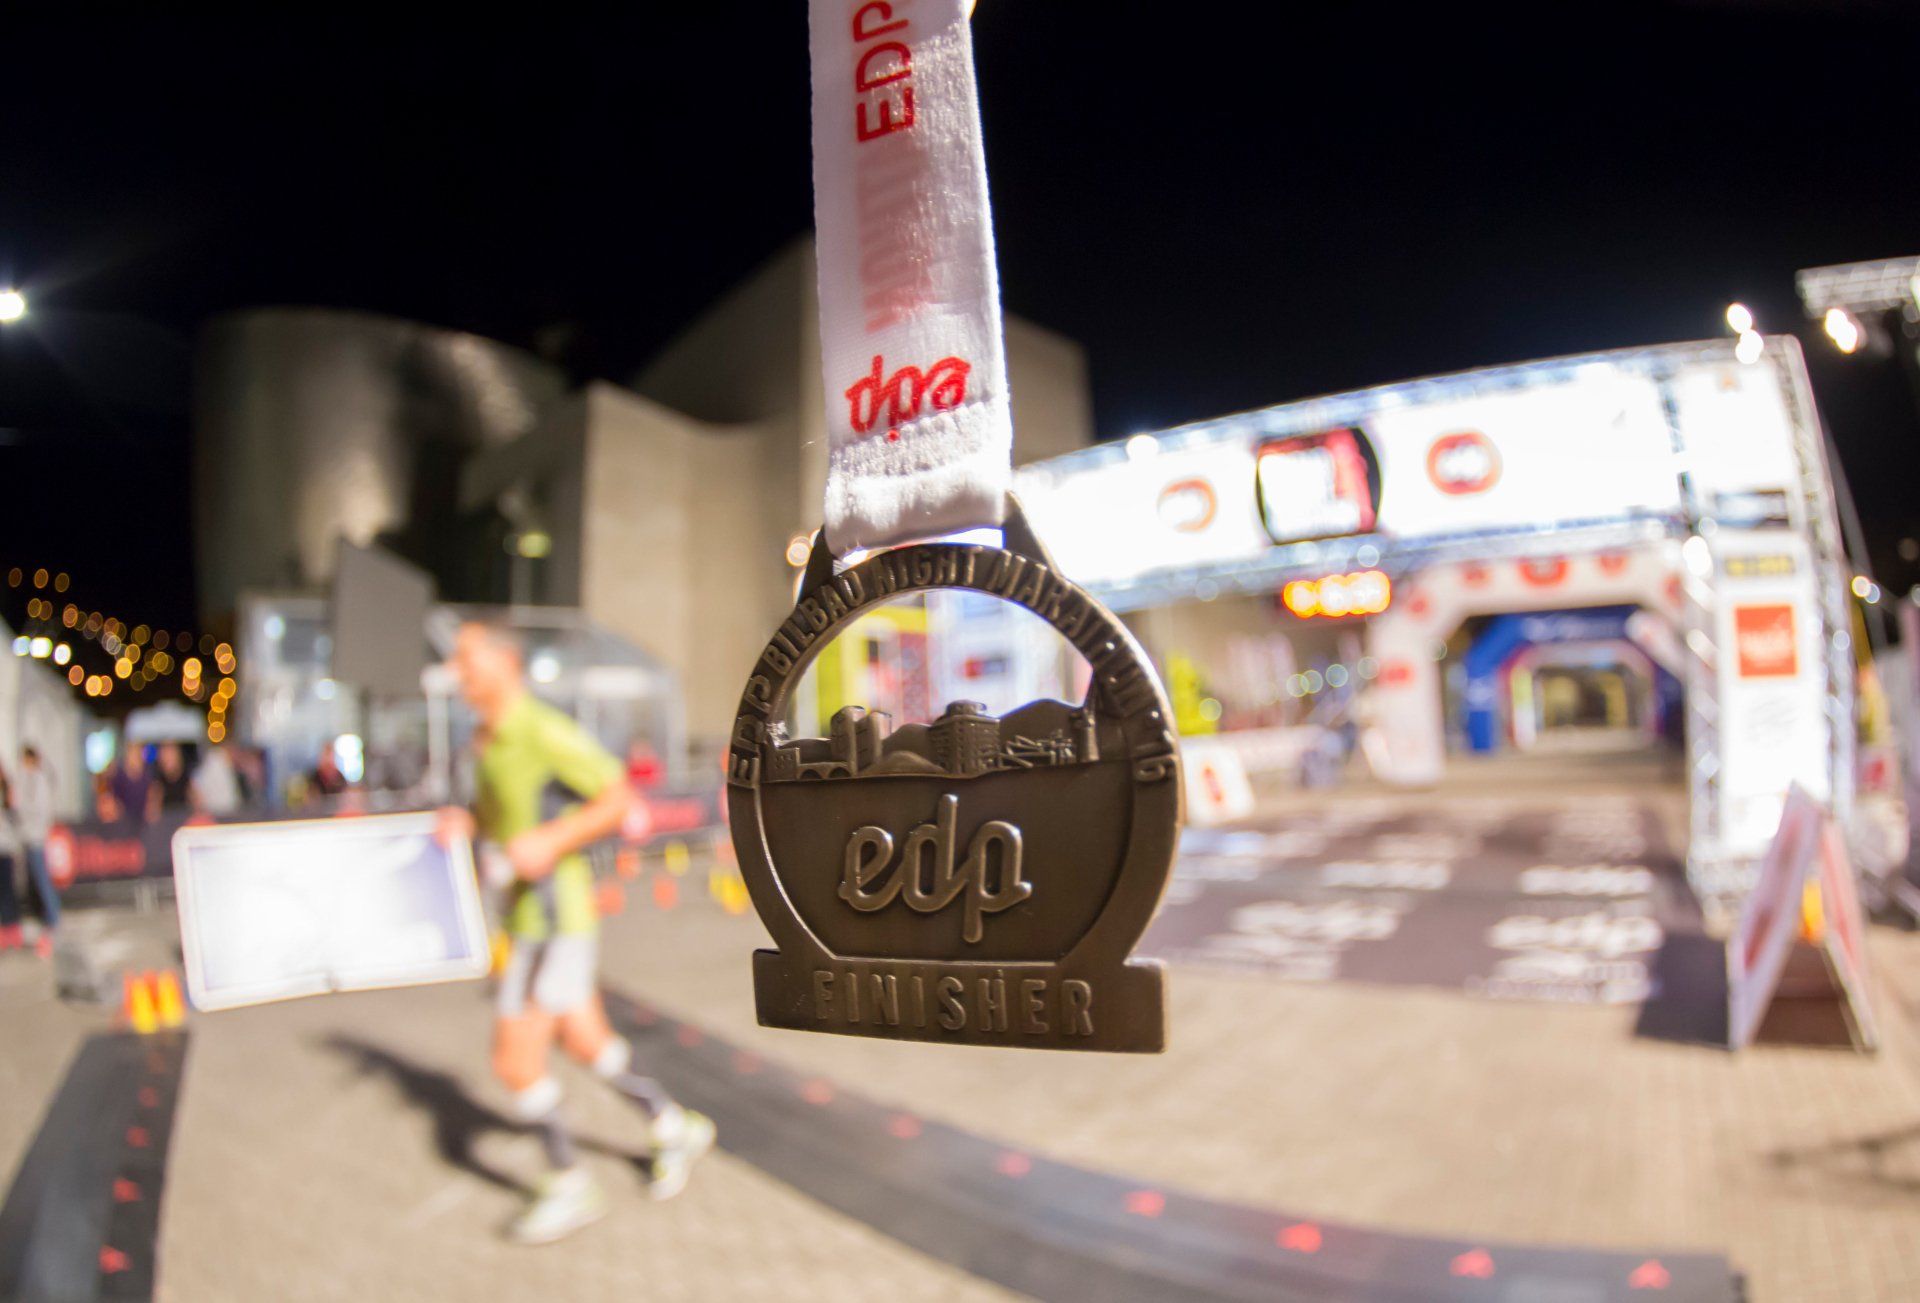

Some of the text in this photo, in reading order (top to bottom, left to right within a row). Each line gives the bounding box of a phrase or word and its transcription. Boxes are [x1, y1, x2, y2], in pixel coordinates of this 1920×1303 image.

[853, 0, 914, 142] EDP
[845, 355, 971, 441] edp
[728, 674, 772, 788] EDP
[763, 570, 865, 677] BILBAO
[874, 547, 987, 594] NIGHT
[838, 793, 1032, 943] edp
[813, 969, 1095, 1036] FINISHER
